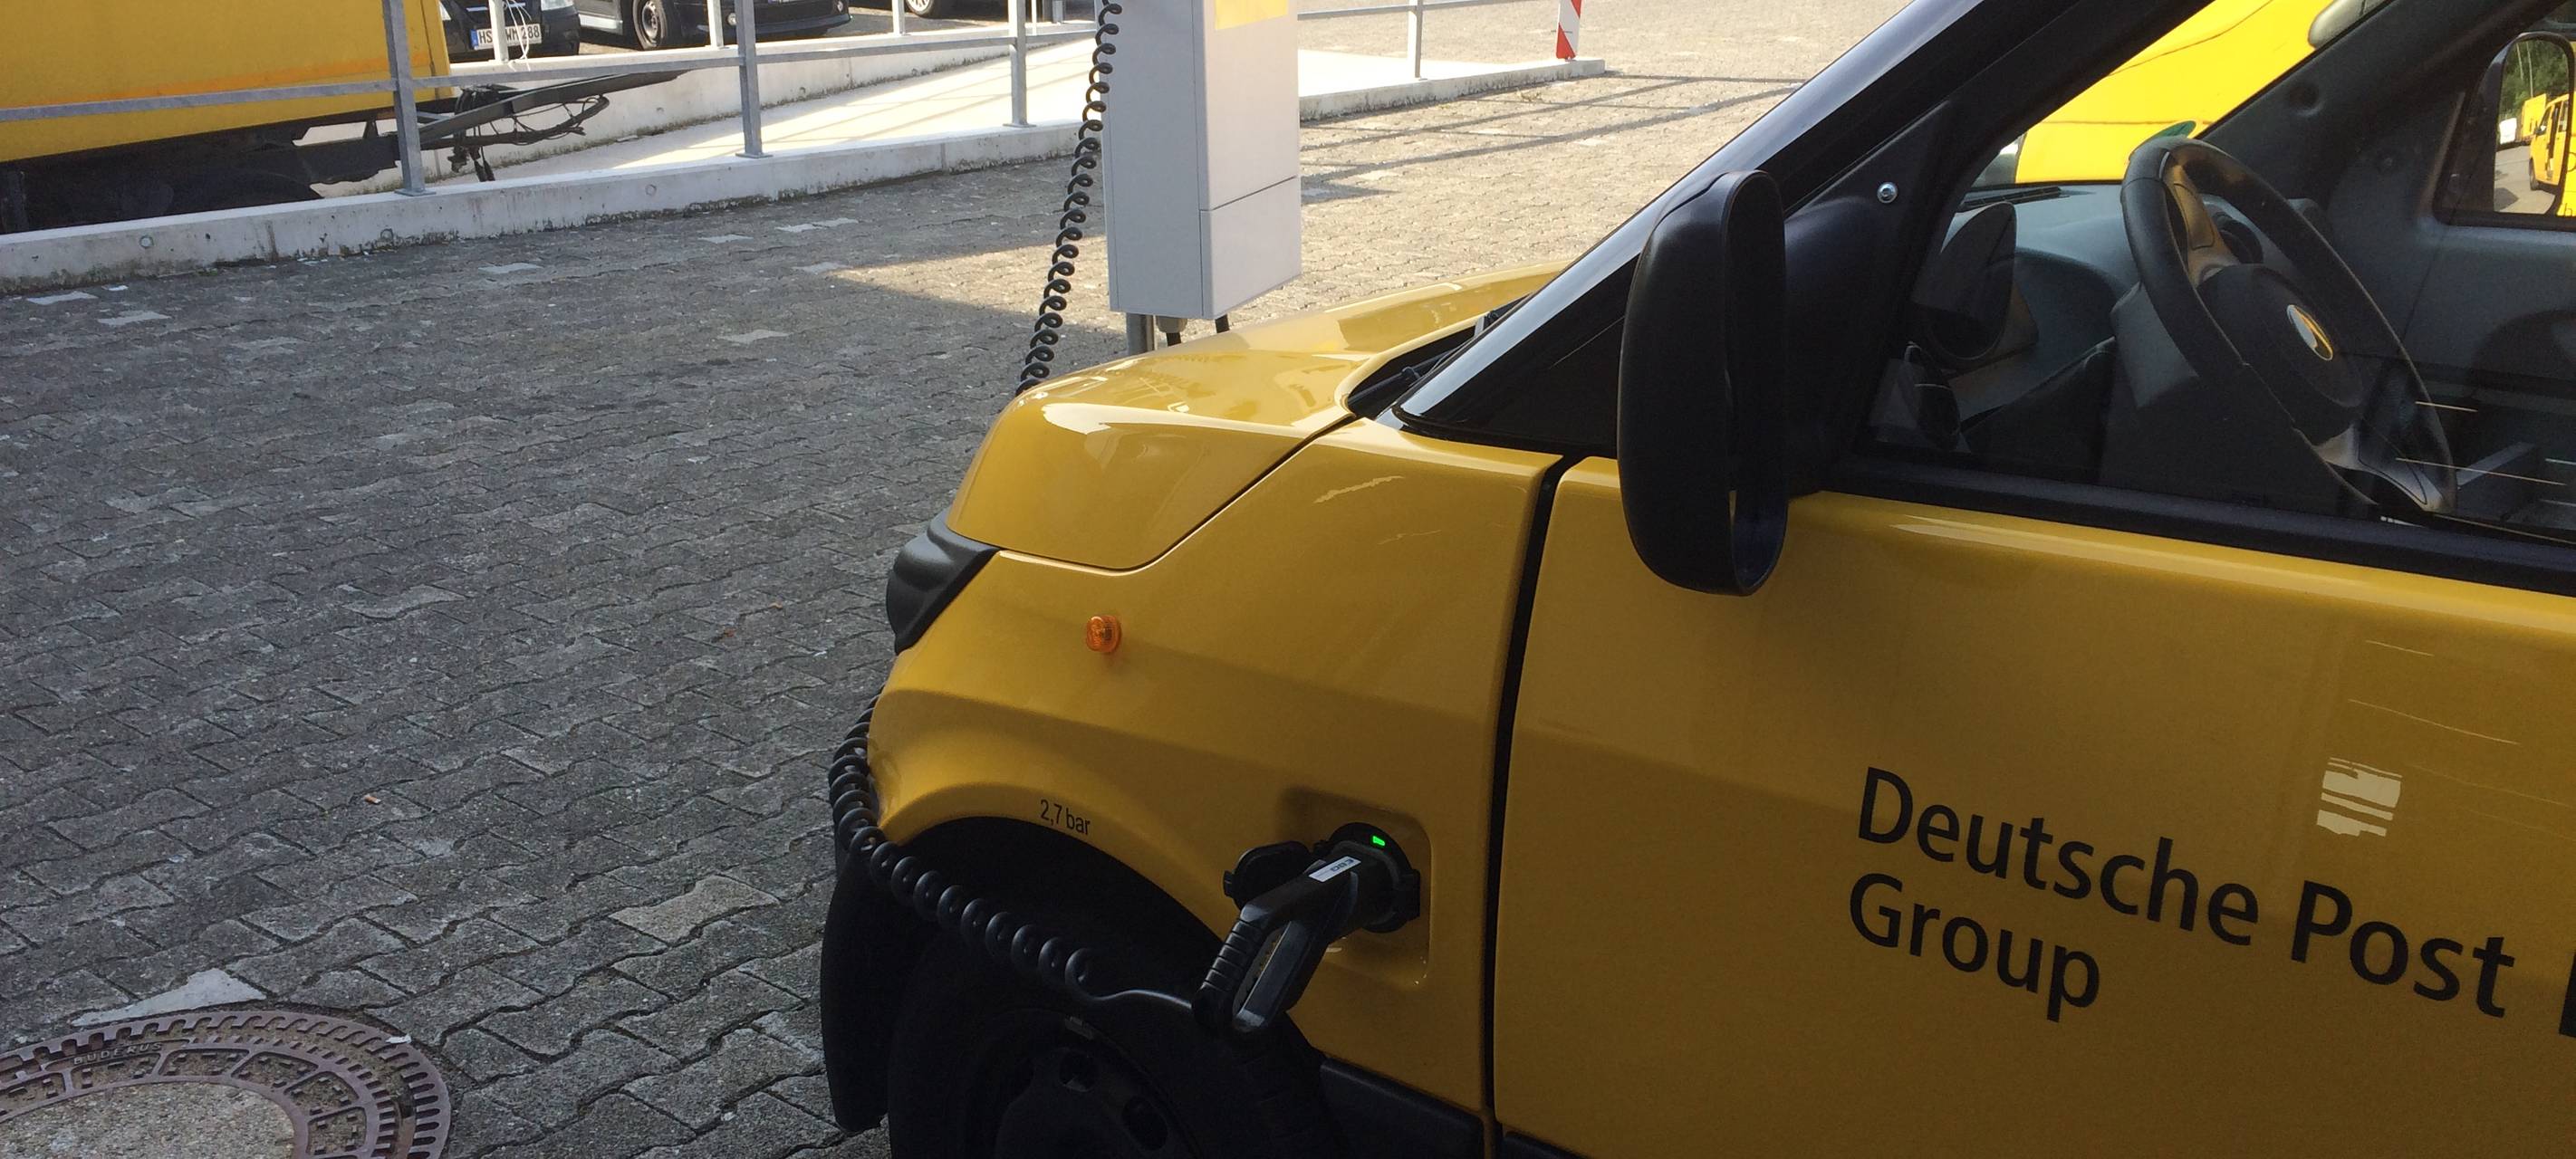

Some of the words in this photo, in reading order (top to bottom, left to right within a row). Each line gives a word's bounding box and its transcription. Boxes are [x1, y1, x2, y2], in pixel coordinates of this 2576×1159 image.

[478, 31, 494, 44] HS
[521, 25, 541, 40] 288
[1040, 799, 1063, 826] 2,7
[1066, 807, 1091, 836] bar
[1858, 766, 2259, 946] Deutsche
[2290, 880, 2515, 1019] Post
[1849, 873, 2100, 1024] Group
[73, 1041, 162, 1065] BUDERUS
